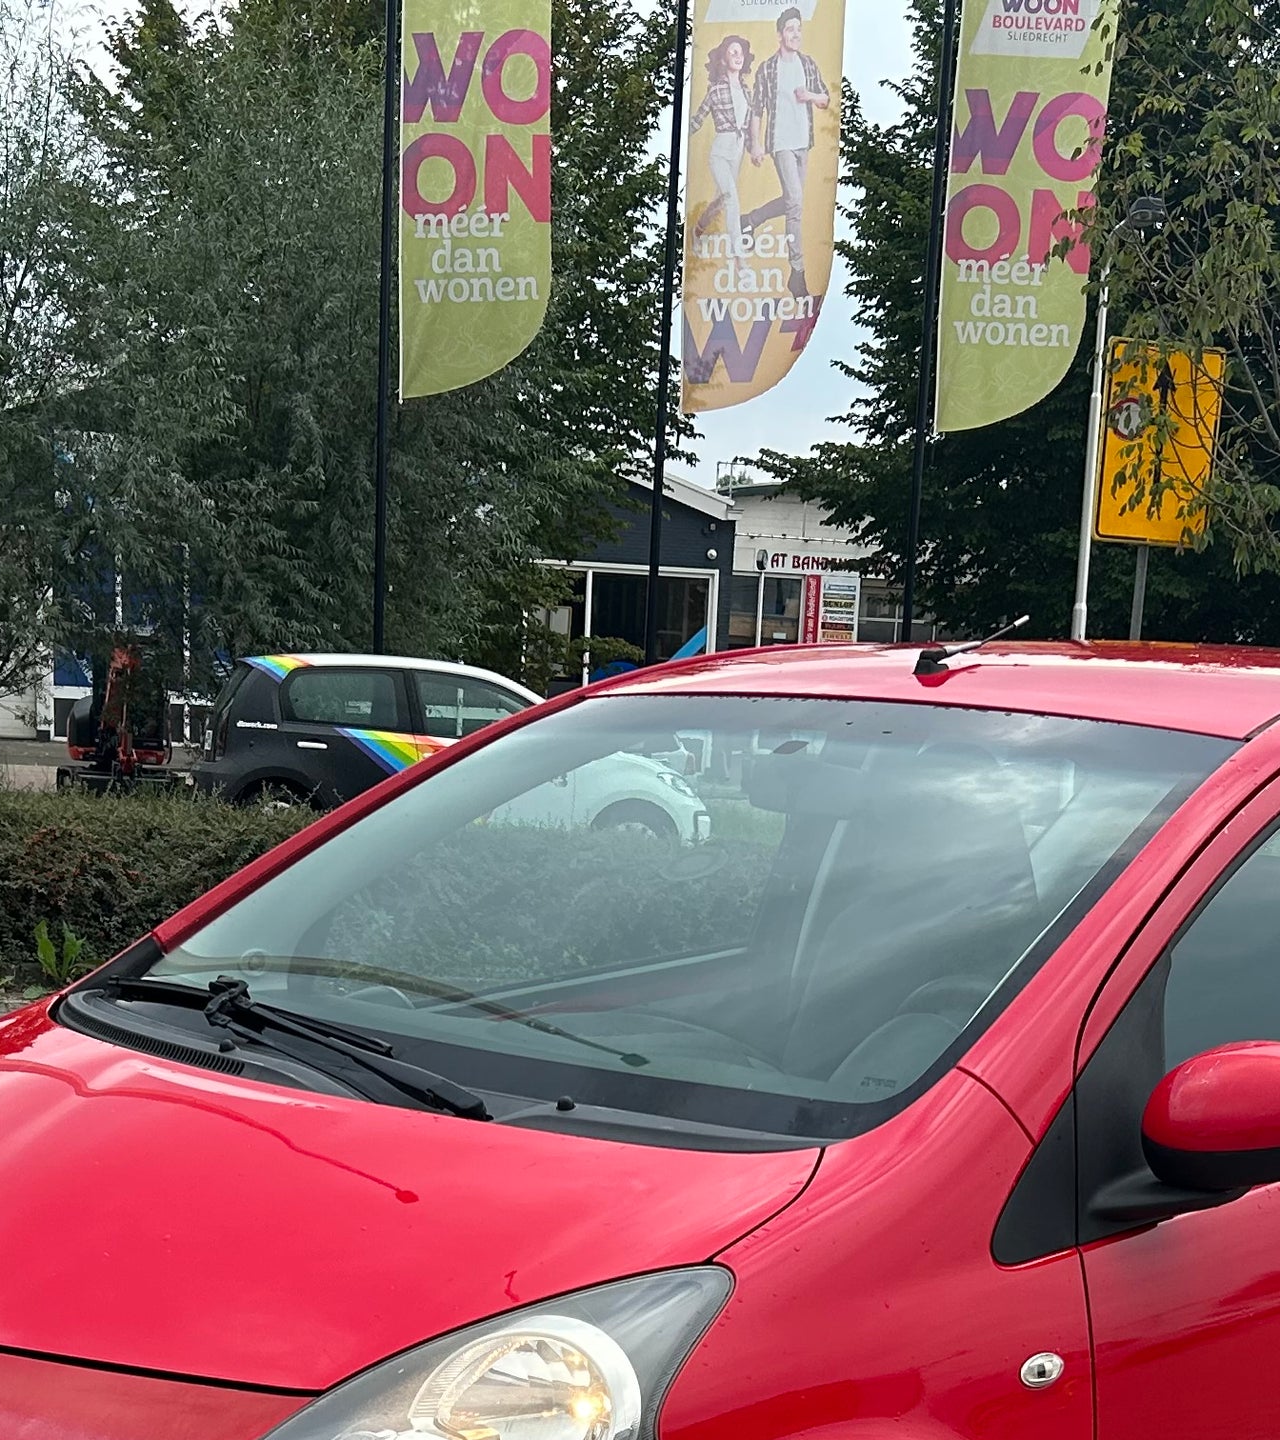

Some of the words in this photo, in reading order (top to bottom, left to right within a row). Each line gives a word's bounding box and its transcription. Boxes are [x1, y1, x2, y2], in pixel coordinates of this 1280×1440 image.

[1003, 0, 1080, 15] WOON
[992, 15, 1086, 32] BOULEVARD
[1008, 31, 1069, 42] SLIEDRECHT
[413, 205, 510, 239] méér
[699, 225, 796, 259] méér
[431, 239, 502, 274] dan
[956, 253, 1048, 286] méér
[413, 275, 539, 303] wonen
[714, 257, 785, 293] dan
[696, 295, 814, 322] wonen
[969, 283, 1038, 319] dan
[953, 319, 1070, 347] wonen
[770, 553, 788, 568] AT
